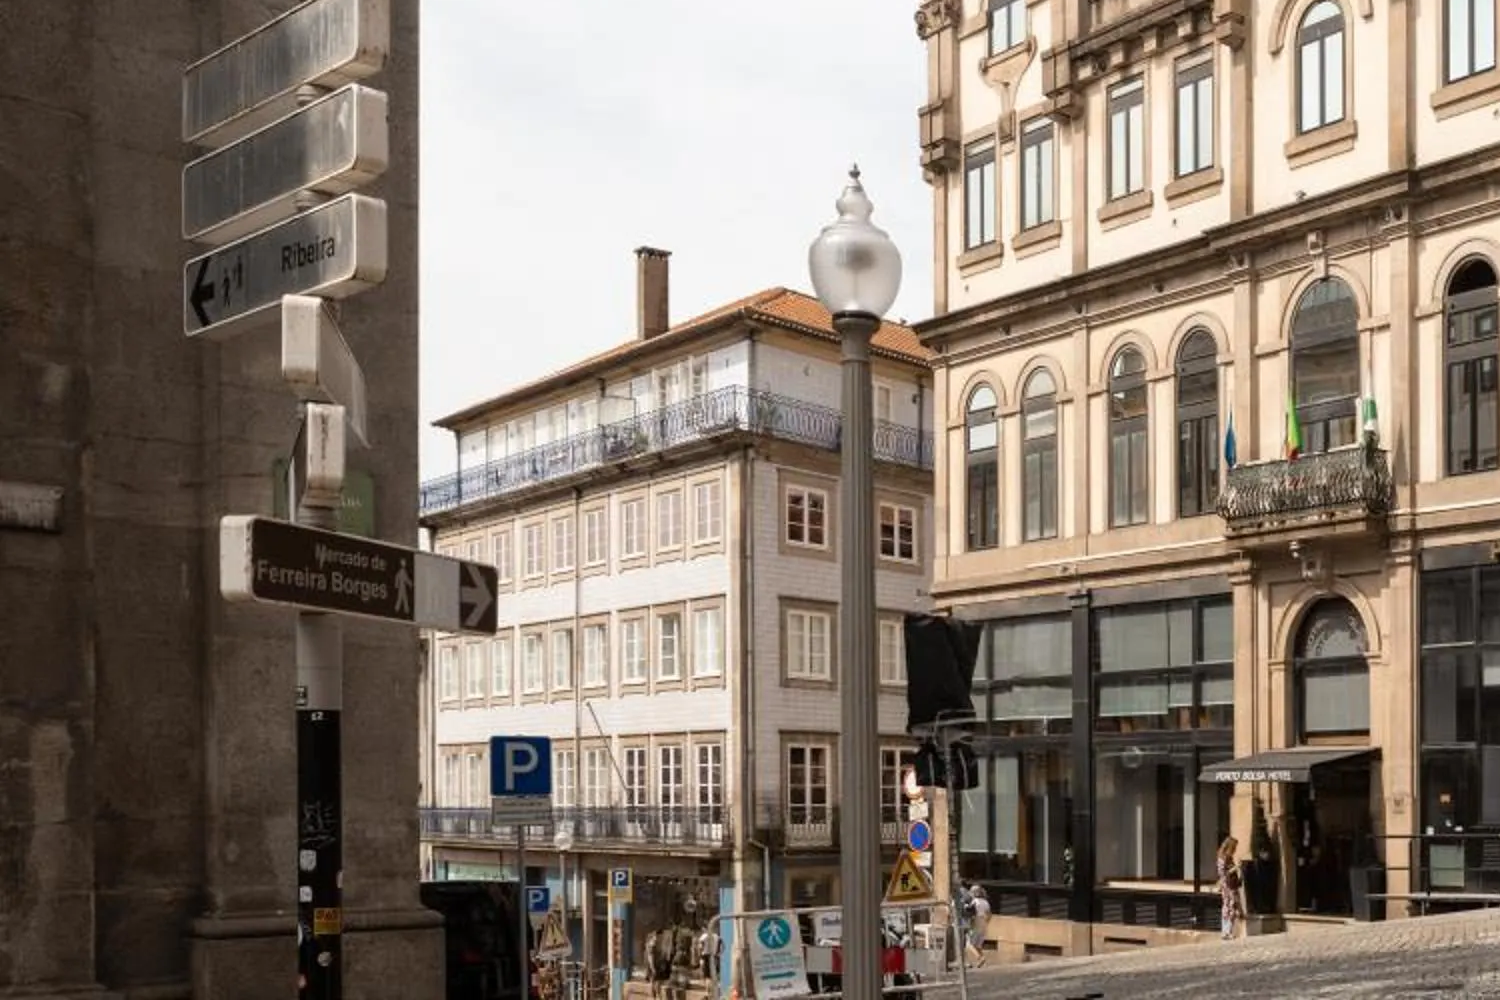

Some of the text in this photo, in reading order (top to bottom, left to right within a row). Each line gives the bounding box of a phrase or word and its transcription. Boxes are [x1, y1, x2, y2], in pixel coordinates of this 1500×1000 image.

[281, 236, 335, 272] Ribeira
[315, 543, 386, 570] Mercado de
[257, 559, 388, 600] Ferreira Borges
[505, 742, 539, 791] P
[1242, 770, 1266, 780] BOLSA
[615, 871, 627, 885] P
[528, 889, 545, 911] P
